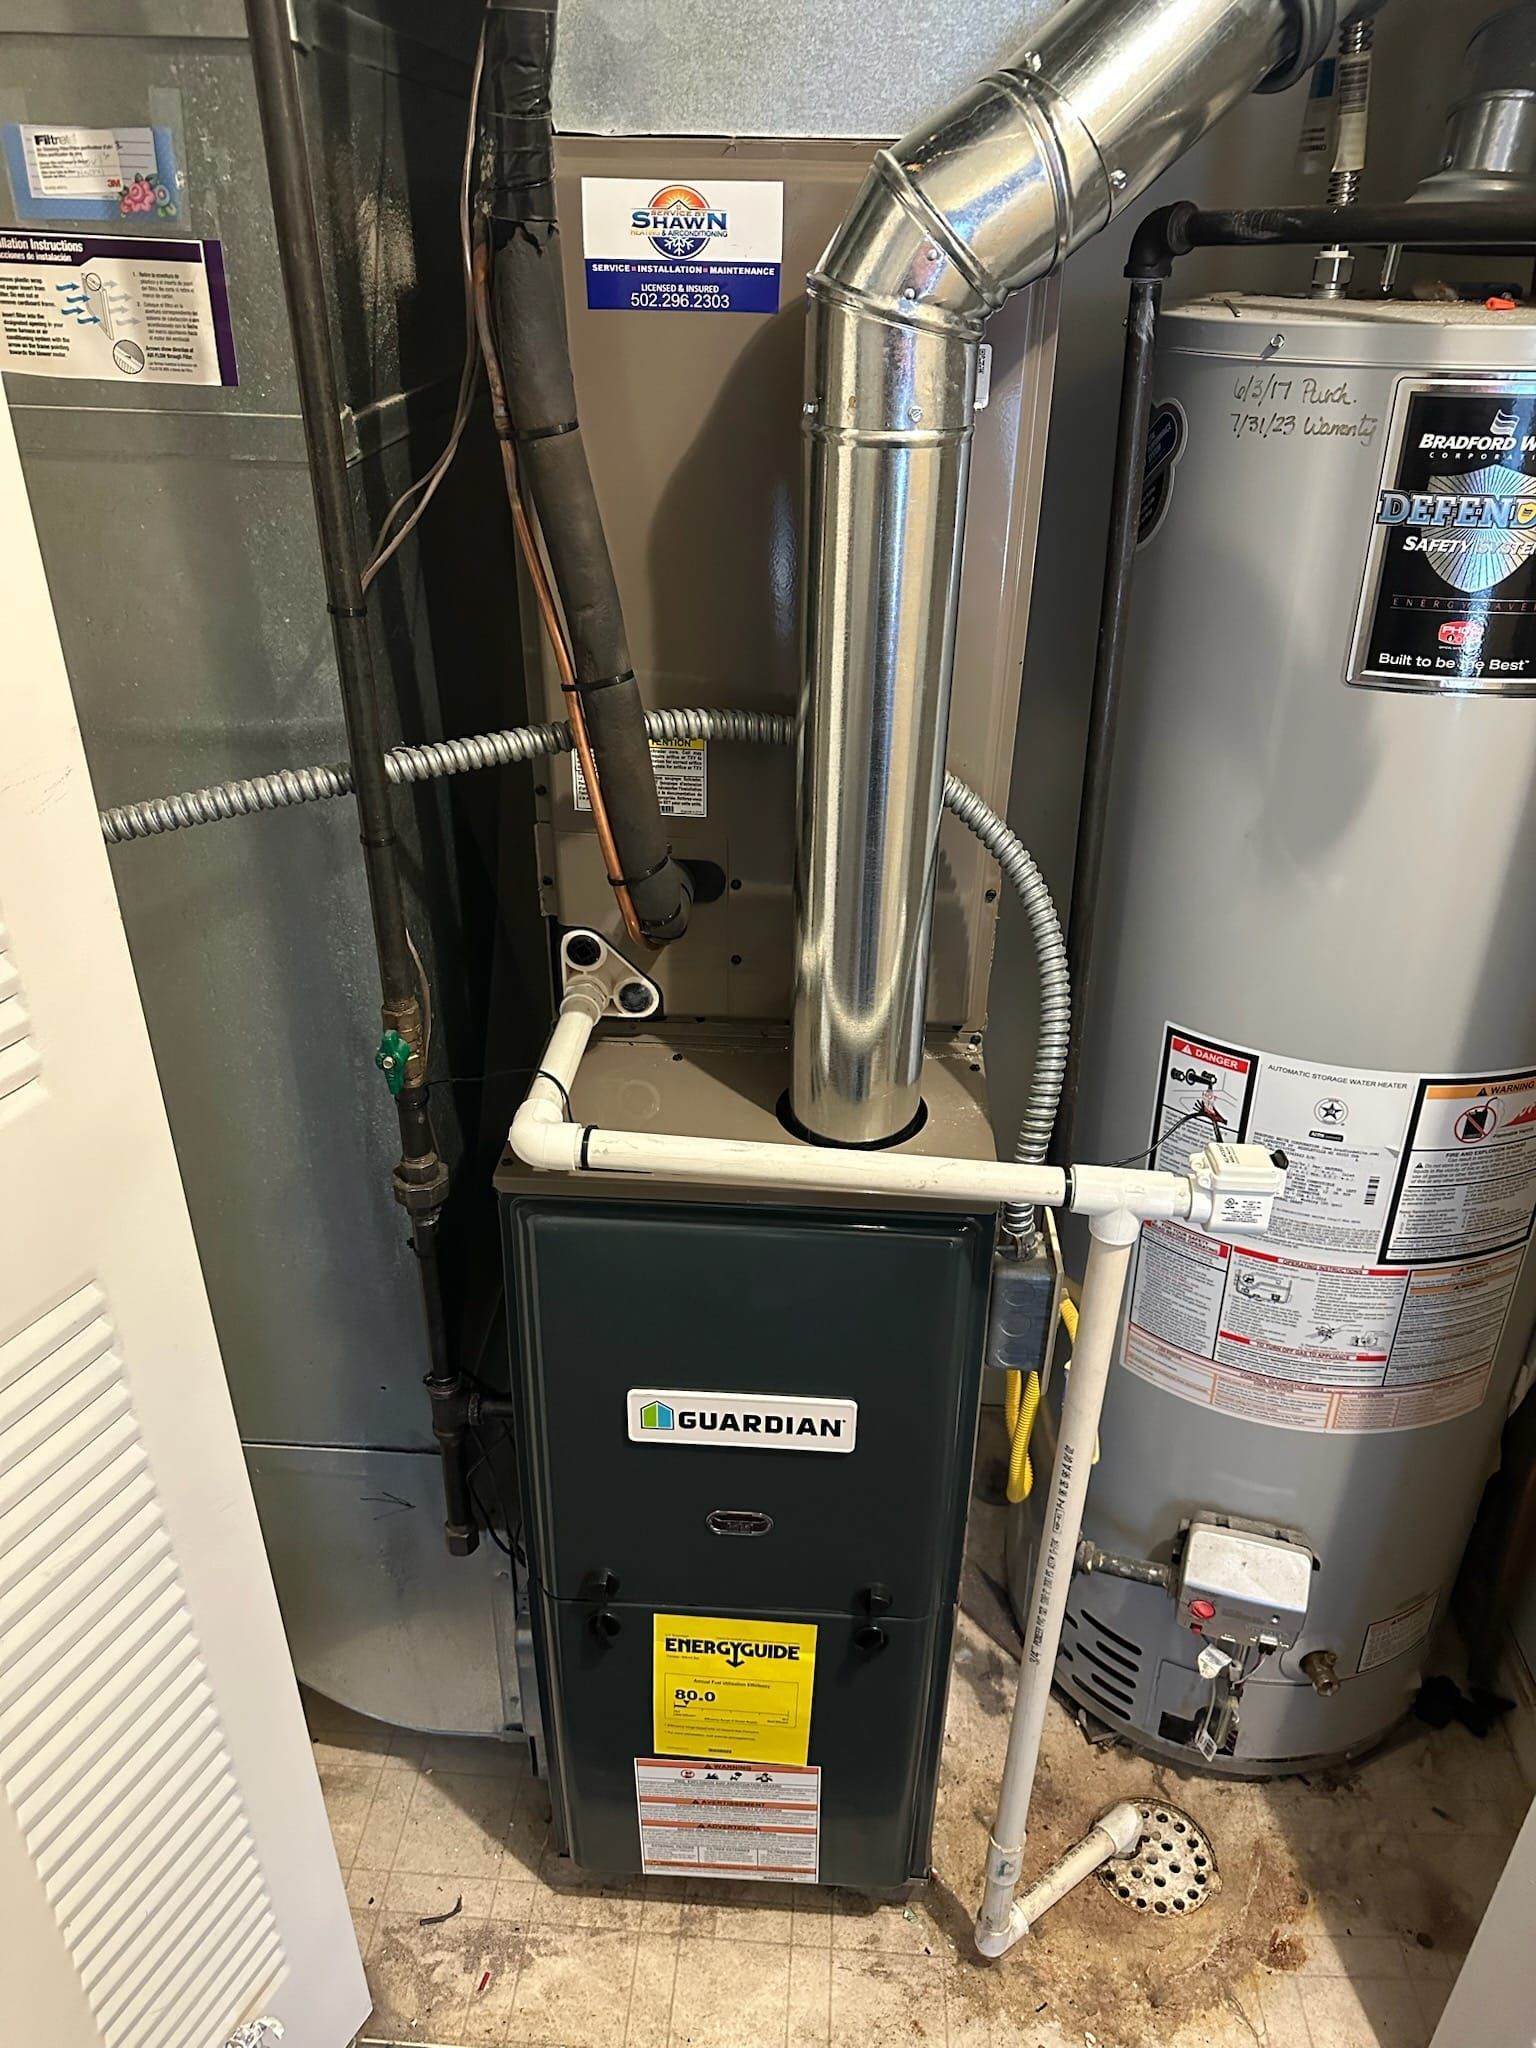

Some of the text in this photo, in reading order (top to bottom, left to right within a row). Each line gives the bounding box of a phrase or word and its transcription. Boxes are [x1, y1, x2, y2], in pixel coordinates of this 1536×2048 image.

[107, 179, 121, 188] 3M
[632, 211, 727, 230] SHAWN
[30, 238, 84, 252] Instructions
[26, 252, 35, 260] de
[592, 264, 775, 276] SERVICE INSTALLATION MAINTENANCE
[641, 284, 719, 294] LICENSED & INSURED
[631, 293, 730, 309] 502.296.2303
[1233, 373, 1293, 407] 6/3/17
[1230, 412, 1297, 439] 7/31/23
[1419, 433, 1517, 451] BRADFORD
[1403, 536, 1536, 555] SAFETY SYSTE
[1379, 653, 1413, 666] Built
[1417, 655, 1432, 667] to
[1436, 657, 1456, 669] be
[1195, 1050, 1239, 1070] DANGER
[1268, 1064, 1408, 1090] AUTOMATIC STORAGE WATER HEATER
[1491, 1080, 1535, 1095] WARNING
[678, 1412, 842, 1437] GUARDIAN
[665, 1637, 801, 1666] ENERGYGUIDE
[674, 1688, 716, 1702] 80.0
[713, 1763, 752, 1771] WARNING
[701, 1800, 766, 1808] AVERTISSEMENT
[707, 1823, 761, 1832] ADVERTENCIA
